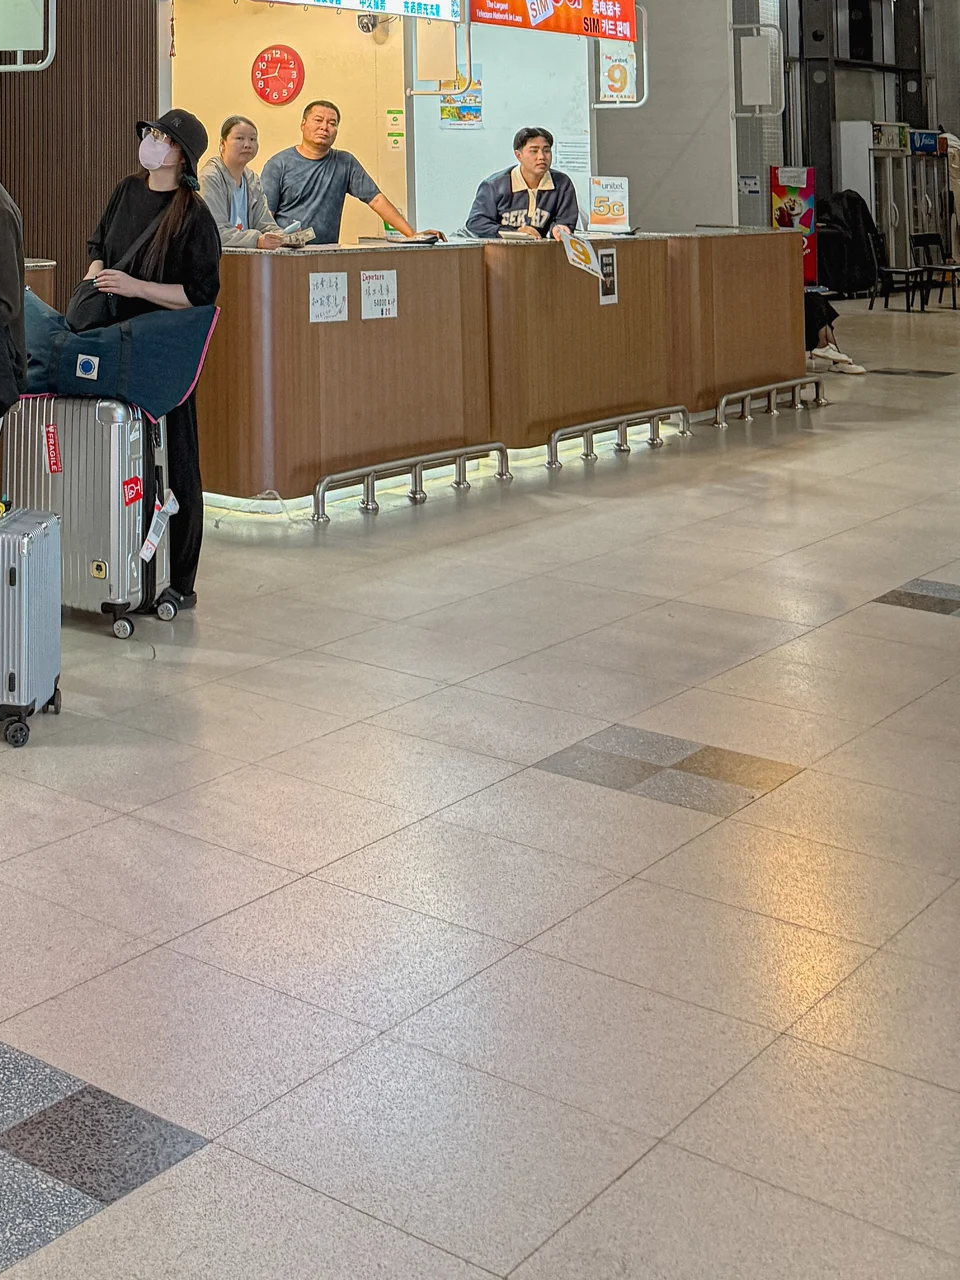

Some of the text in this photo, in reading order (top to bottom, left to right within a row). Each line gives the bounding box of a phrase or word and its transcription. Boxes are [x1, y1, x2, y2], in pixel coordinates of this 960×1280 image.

[583, 17, 599, 33] SIM
[255, 71, 262, 79] 9
[291, 71, 297, 79] 3
[607, 64, 627, 93] 9
[258, 80, 264, 88] 8
[288, 81, 294, 89] 4
[602, 182, 624, 190] unitel
[594, 196, 625, 216] 5G
[569, 239, 592, 265] 9
[48, 433, 57, 472] FRAGILE
